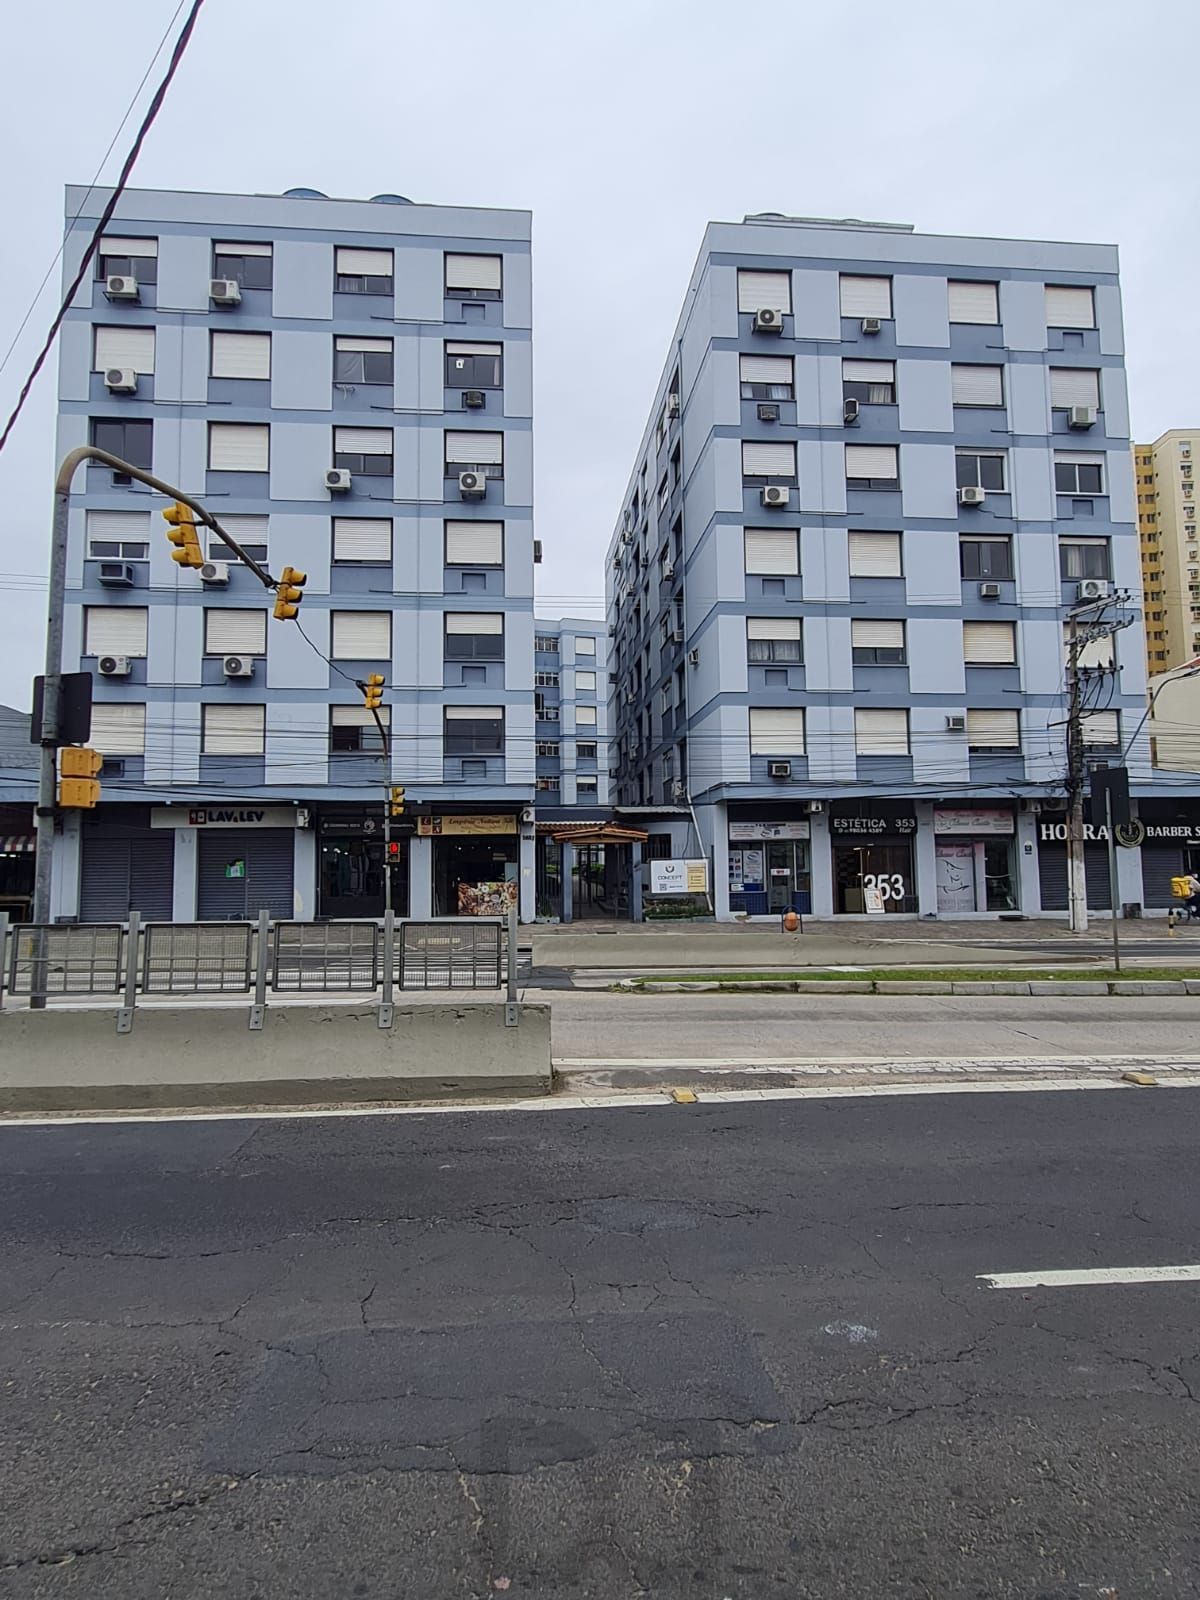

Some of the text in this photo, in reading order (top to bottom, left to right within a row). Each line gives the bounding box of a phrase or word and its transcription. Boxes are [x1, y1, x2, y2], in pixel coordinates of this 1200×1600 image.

[833, 817, 916, 828] ESTÉTICA 353
[1040, 823, 1110, 840] HORA
[1146, 826, 1193, 837] BARBER
